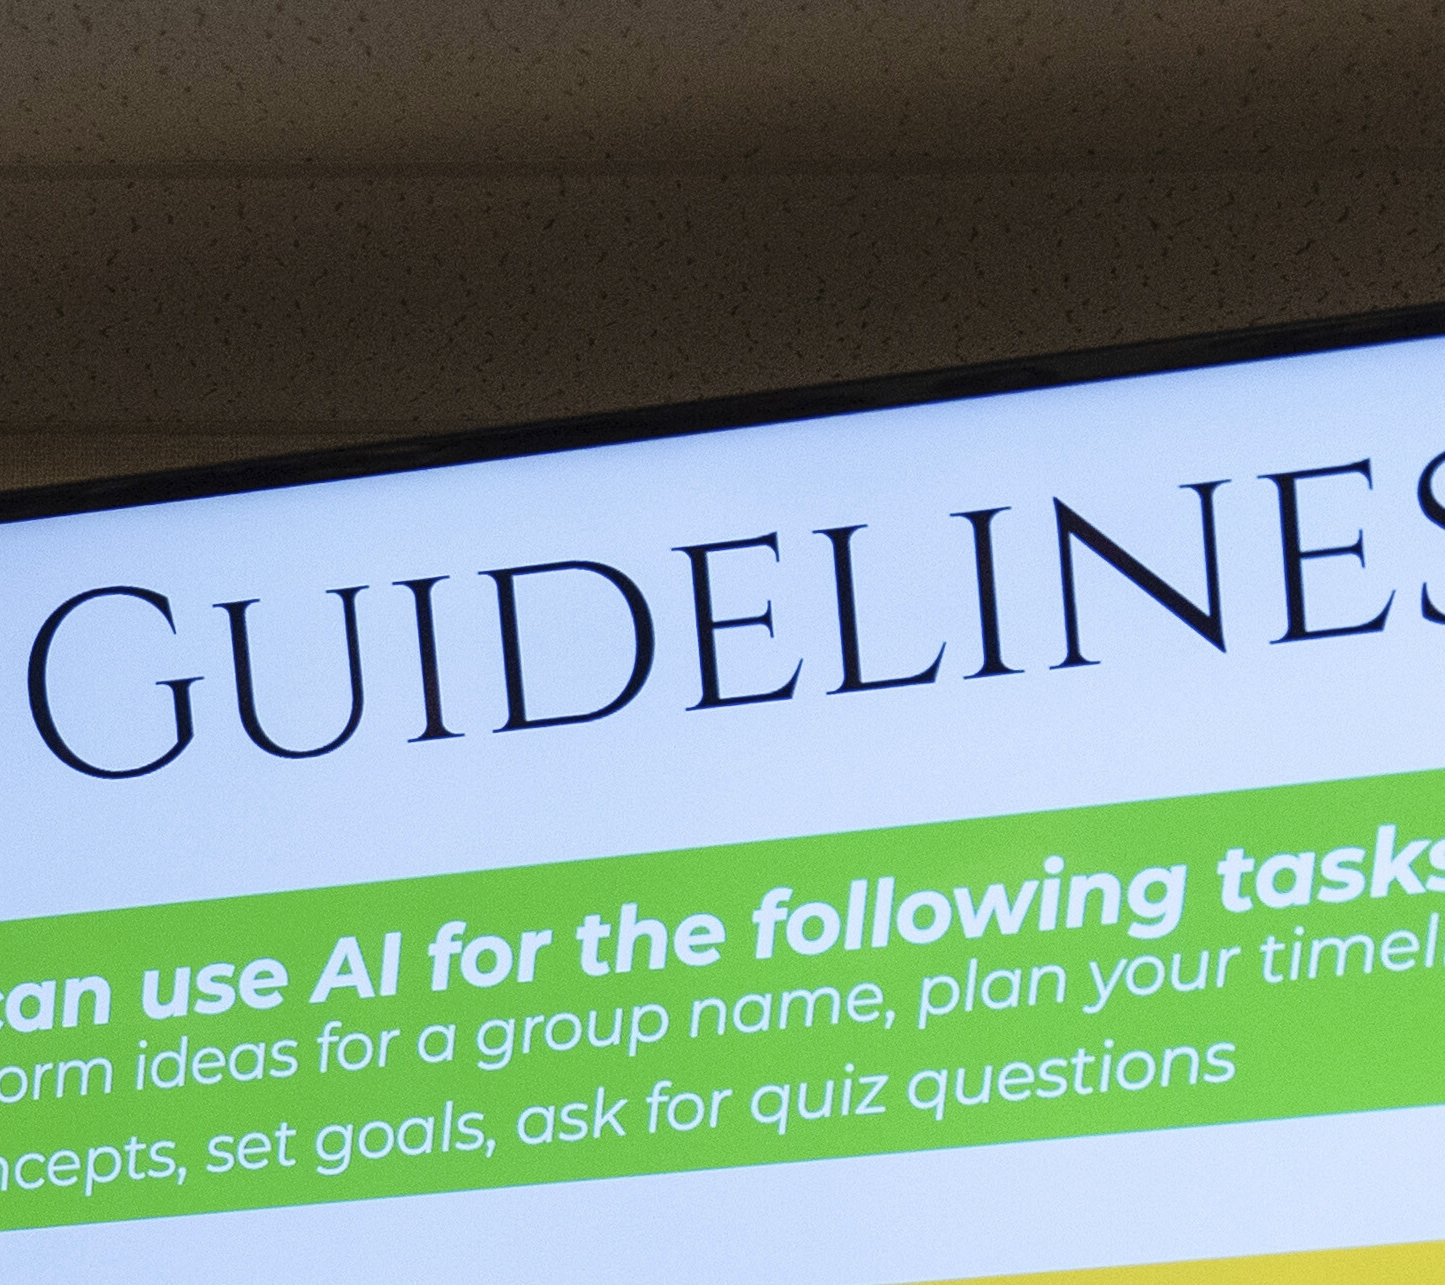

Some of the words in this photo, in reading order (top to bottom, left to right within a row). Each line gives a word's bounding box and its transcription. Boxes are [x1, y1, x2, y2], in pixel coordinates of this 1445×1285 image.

[141, 957, 289, 1021] use
[308, 930, 403, 1005] AI
[427, 919, 554, 992] for
[574, 901, 727, 977] the
[751, 853, 1189, 960] following
[135, 1034, 299, 1090] ideas
[316, 1019, 401, 1073] for
[416, 1023, 457, 1064] a
[475, 1002, 670, 1071] group
[689, 981, 896, 1039] name,
[917, 957, 1067, 1030] plan
[1082, 945, 1242, 1015] your
[205, 1121, 297, 1174] set
[314, 1099, 496, 1176] goals,
[516, 1086, 628, 1146] ask
[645, 1079, 733, 1134] for
[749, 1062, 890, 1136] quiz
[906, 1038, 1237, 1122] questions
